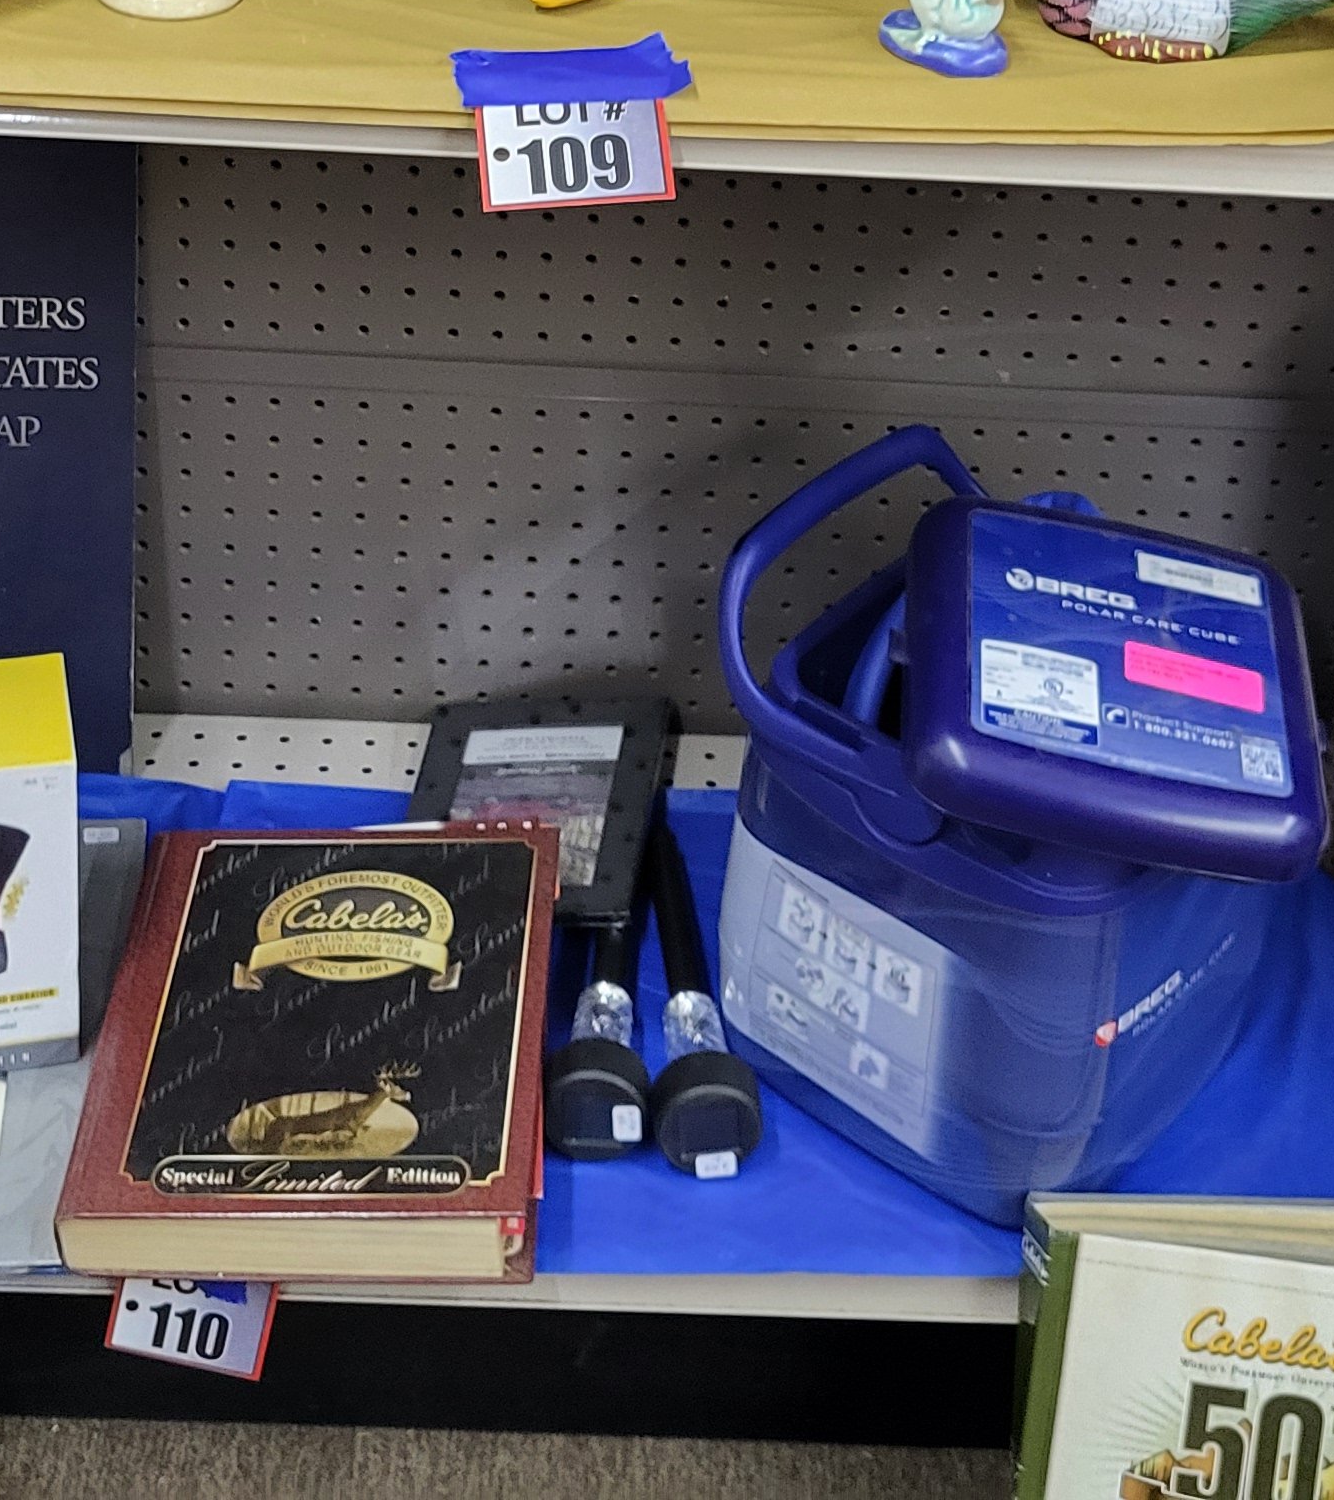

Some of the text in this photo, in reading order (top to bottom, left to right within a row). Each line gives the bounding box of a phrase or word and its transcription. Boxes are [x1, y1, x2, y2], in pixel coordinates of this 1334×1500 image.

[517, 133, 631, 195] 109
[1035, 574, 1138, 611] BREG
[1062, 600, 1241, 646] POLAR CARE CUBE
[284, 898, 429, 933] Cabela's
[318, 873, 398, 890] FOREMOST
[402, 879, 448, 931] OUTFITTER
[295, 934, 414, 948] HUNTING FISHING
[385, 946, 422, 959] GEAR
[304, 961, 348, 976] SINCE
[161, 1160, 461, 1192] Special Limited Edition
[149, 1302, 230, 1360] 110
[1171, 1381, 1325, 1500] 50
